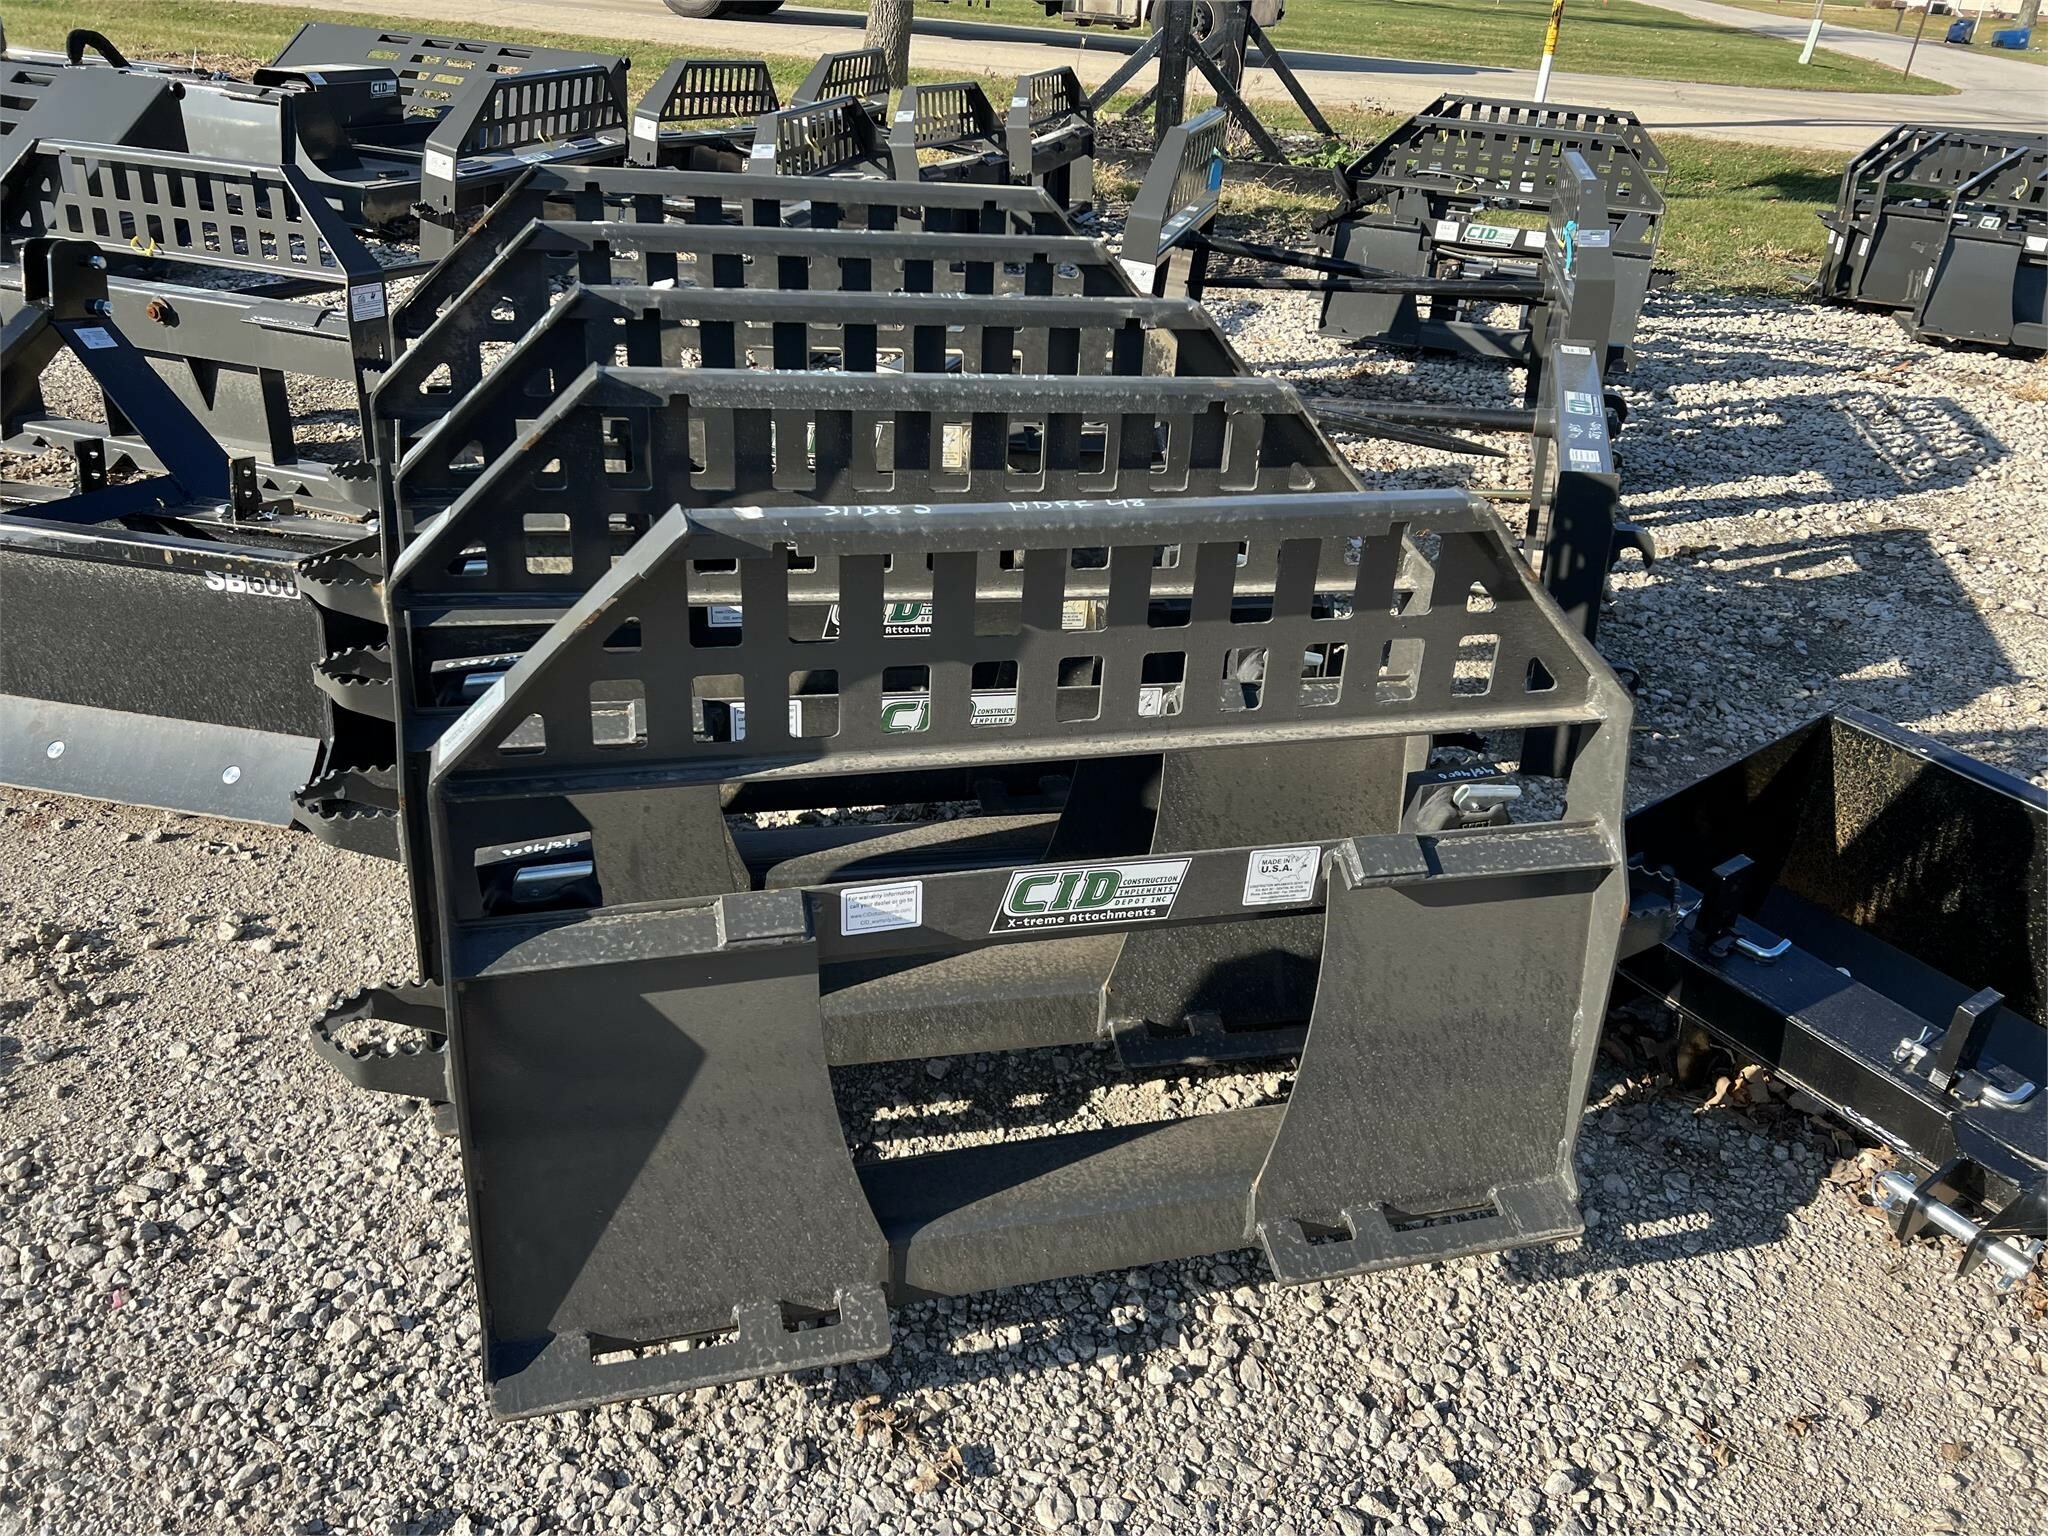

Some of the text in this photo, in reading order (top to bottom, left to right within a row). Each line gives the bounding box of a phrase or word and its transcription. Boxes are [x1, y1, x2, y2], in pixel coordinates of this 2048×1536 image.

[372, 82, 388, 93] CID
[1981, 218, 2000, 229] CI
[1467, 226, 1498, 239] CID
[885, 625, 931, 634] Attachm
[1261, 864, 1293, 873] U.S.A.
[1122, 876, 1179, 885] CONSTRUCTION
[1009, 869, 1122, 913] CID
[1119, 886, 1174, 895] IMPLEMENTS
[1114, 896, 1168, 906] DEPOT INC
[1008, 907, 1157, 928] X-treme Attachments
